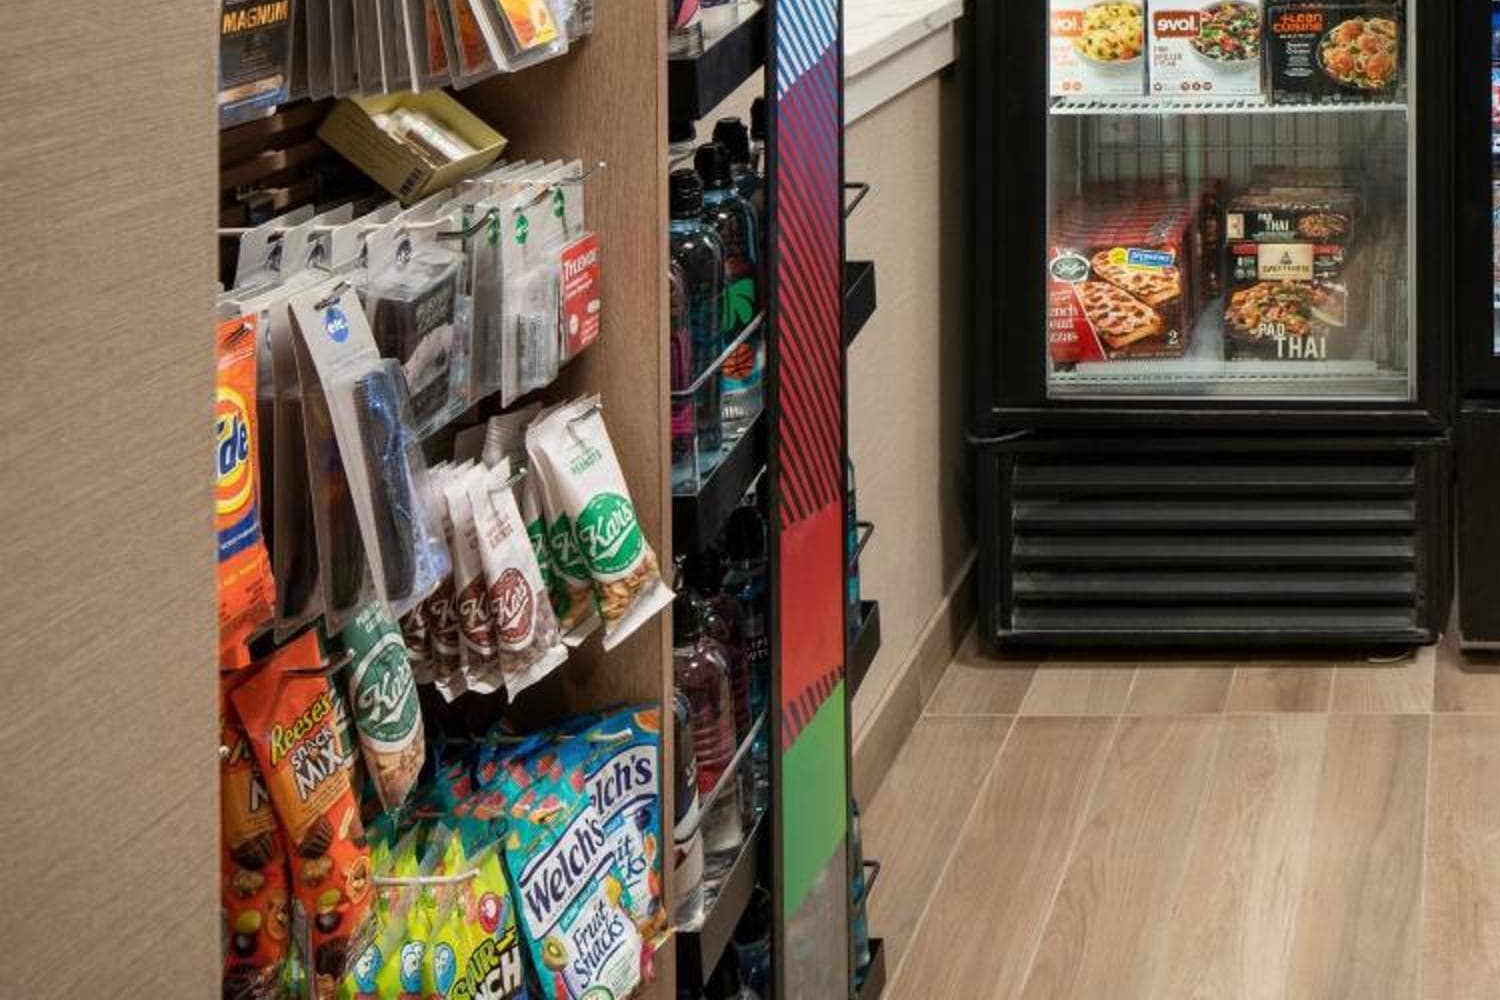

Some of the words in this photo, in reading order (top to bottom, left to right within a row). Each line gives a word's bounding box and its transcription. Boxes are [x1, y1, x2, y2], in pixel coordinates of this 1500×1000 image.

[223, 0, 289, 34] MAGNUM
[1257, 321, 1286, 339] PAD
[1274, 335, 1328, 359] THAI
[296, 739, 343, 801] MIX
[523, 817, 606, 924] Welch's
[572, 899, 611, 956] Fruit
[573, 914, 625, 989] Snacks
